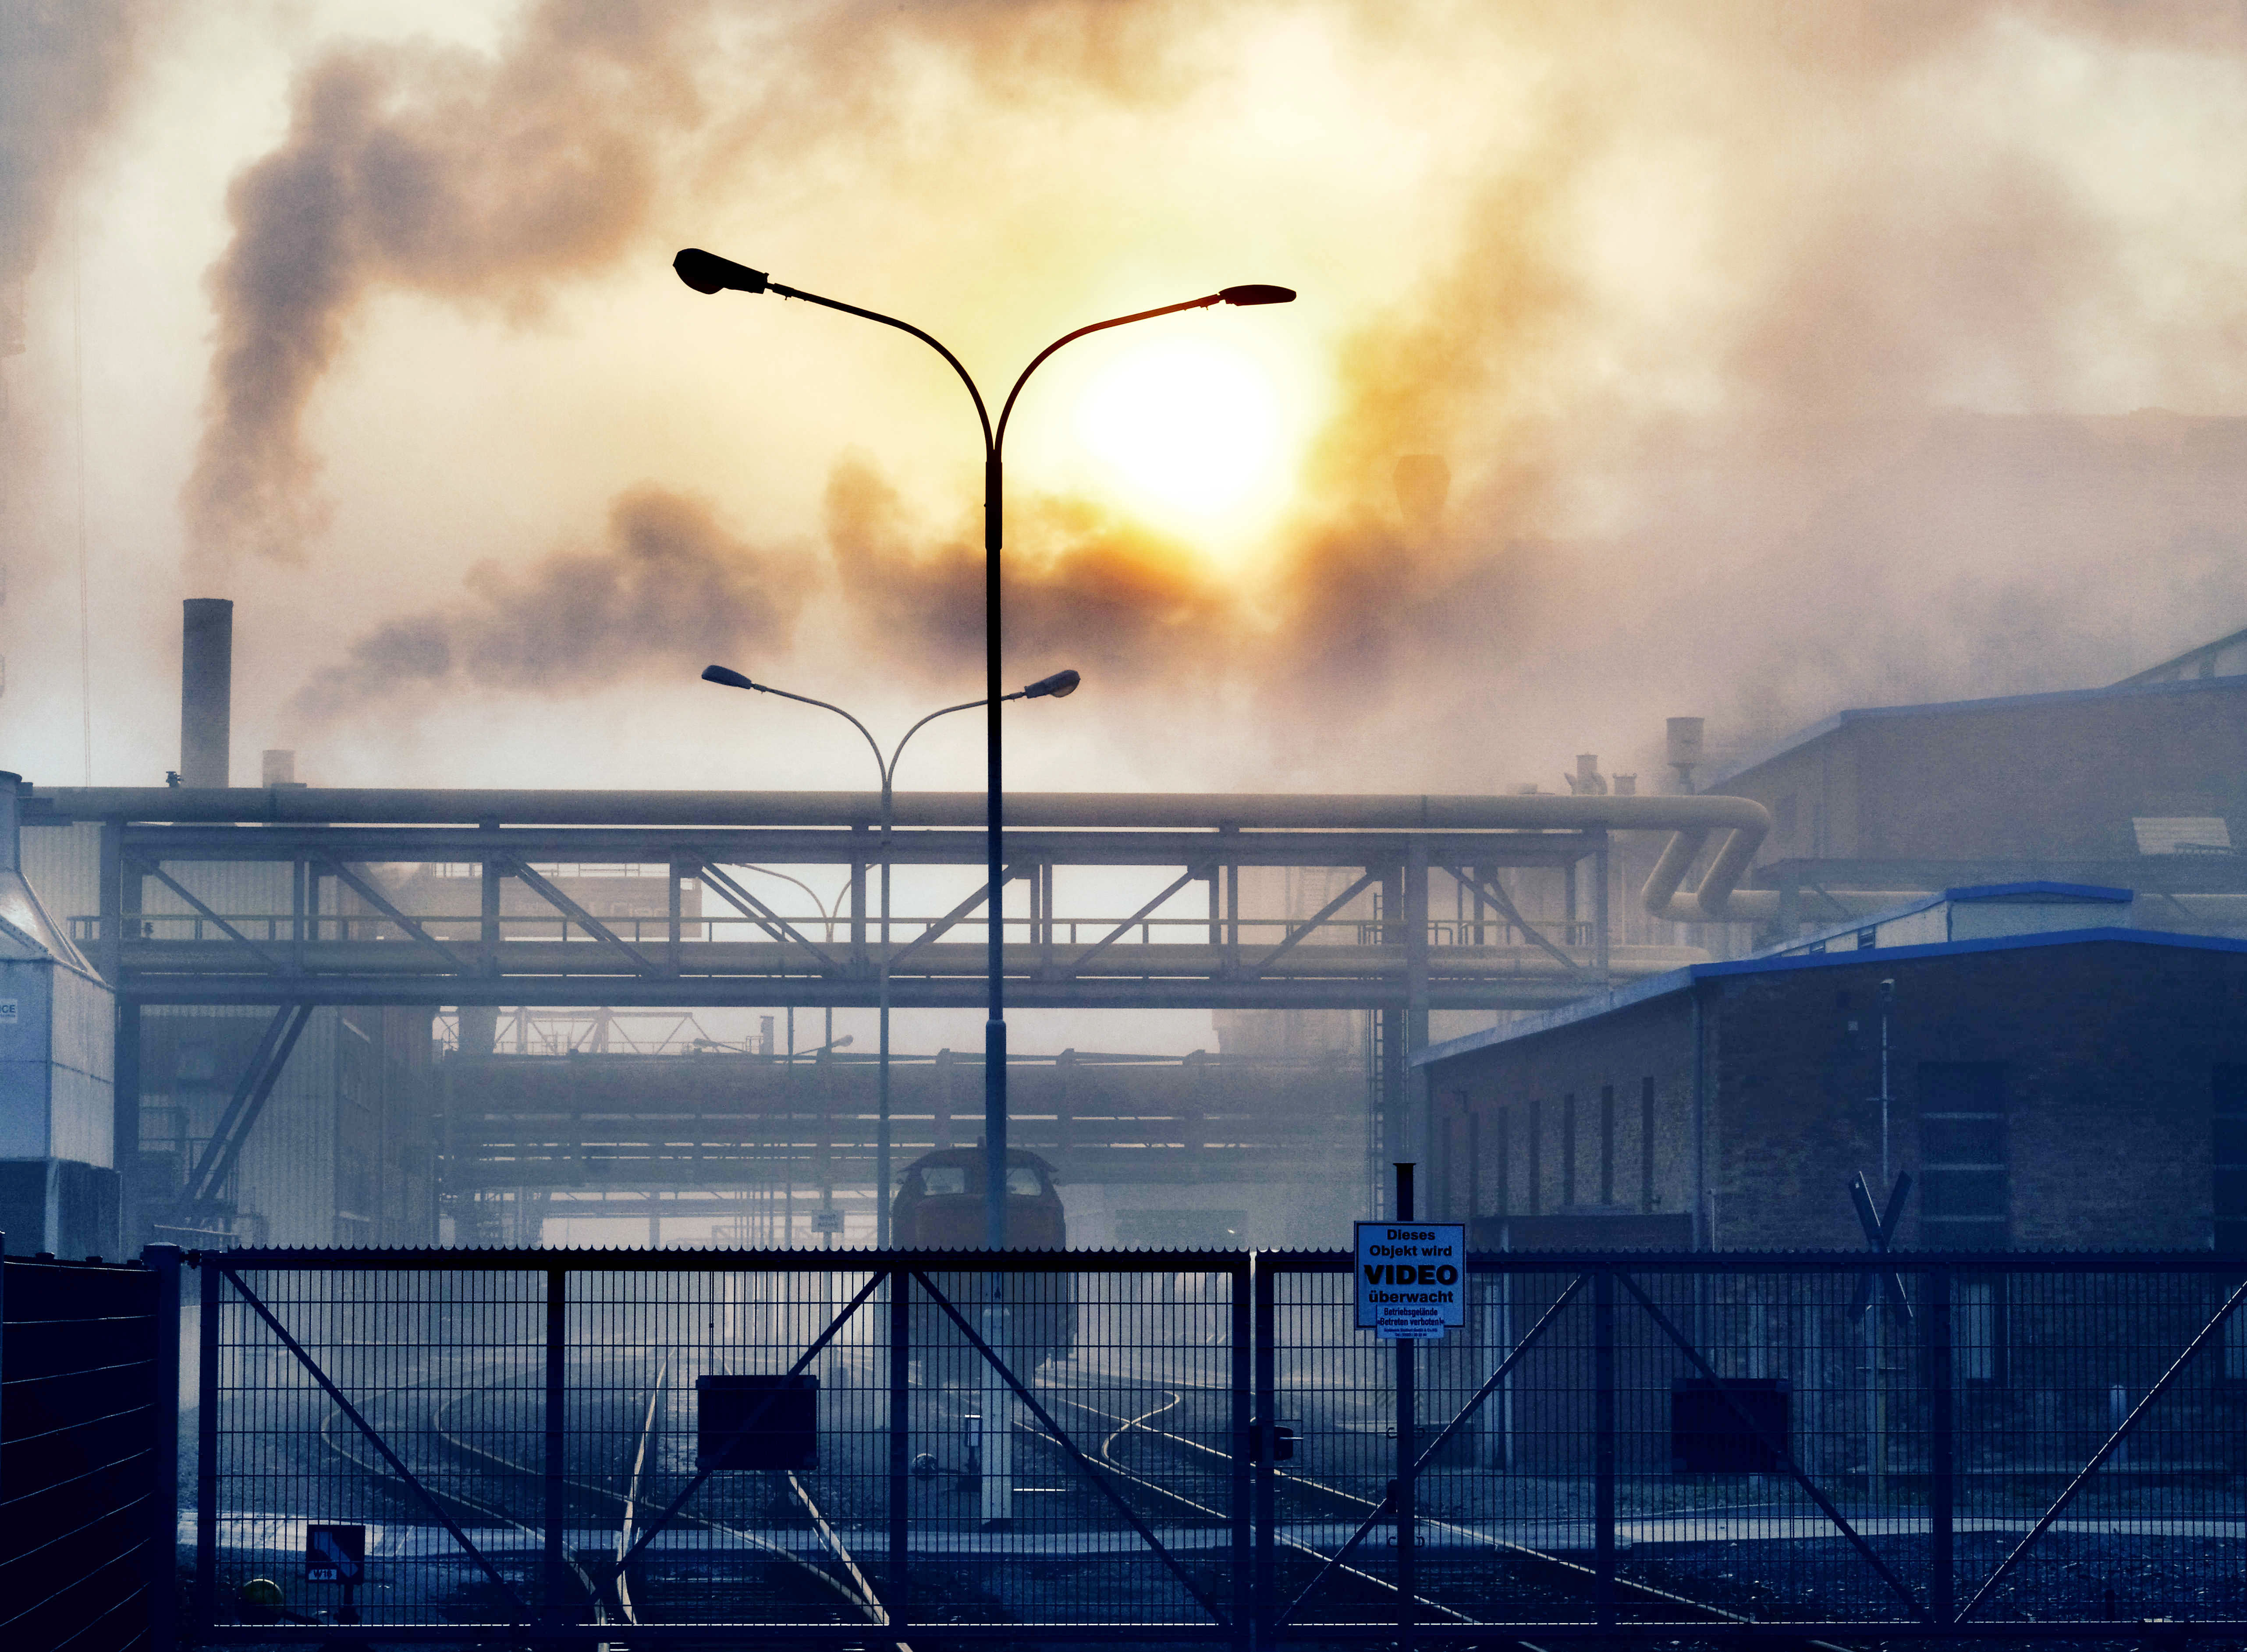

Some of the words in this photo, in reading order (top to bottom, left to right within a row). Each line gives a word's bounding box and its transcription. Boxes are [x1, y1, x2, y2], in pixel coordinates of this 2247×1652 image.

[0, 1005, 15, 1013] CE
[1387, 1229, 1435, 1240] Dieses
[1370, 1245, 1417, 1258] Objekt
[1422, 1245, 1452, 1256] wird
[1364, 1265, 1459, 1285] VIDEO
[1369, 1290, 1453, 1303] überwacht
[1384, 1307, 1438, 1317] Betriebsgelände
[1381, 1317, 1408, 1326] Betreten
